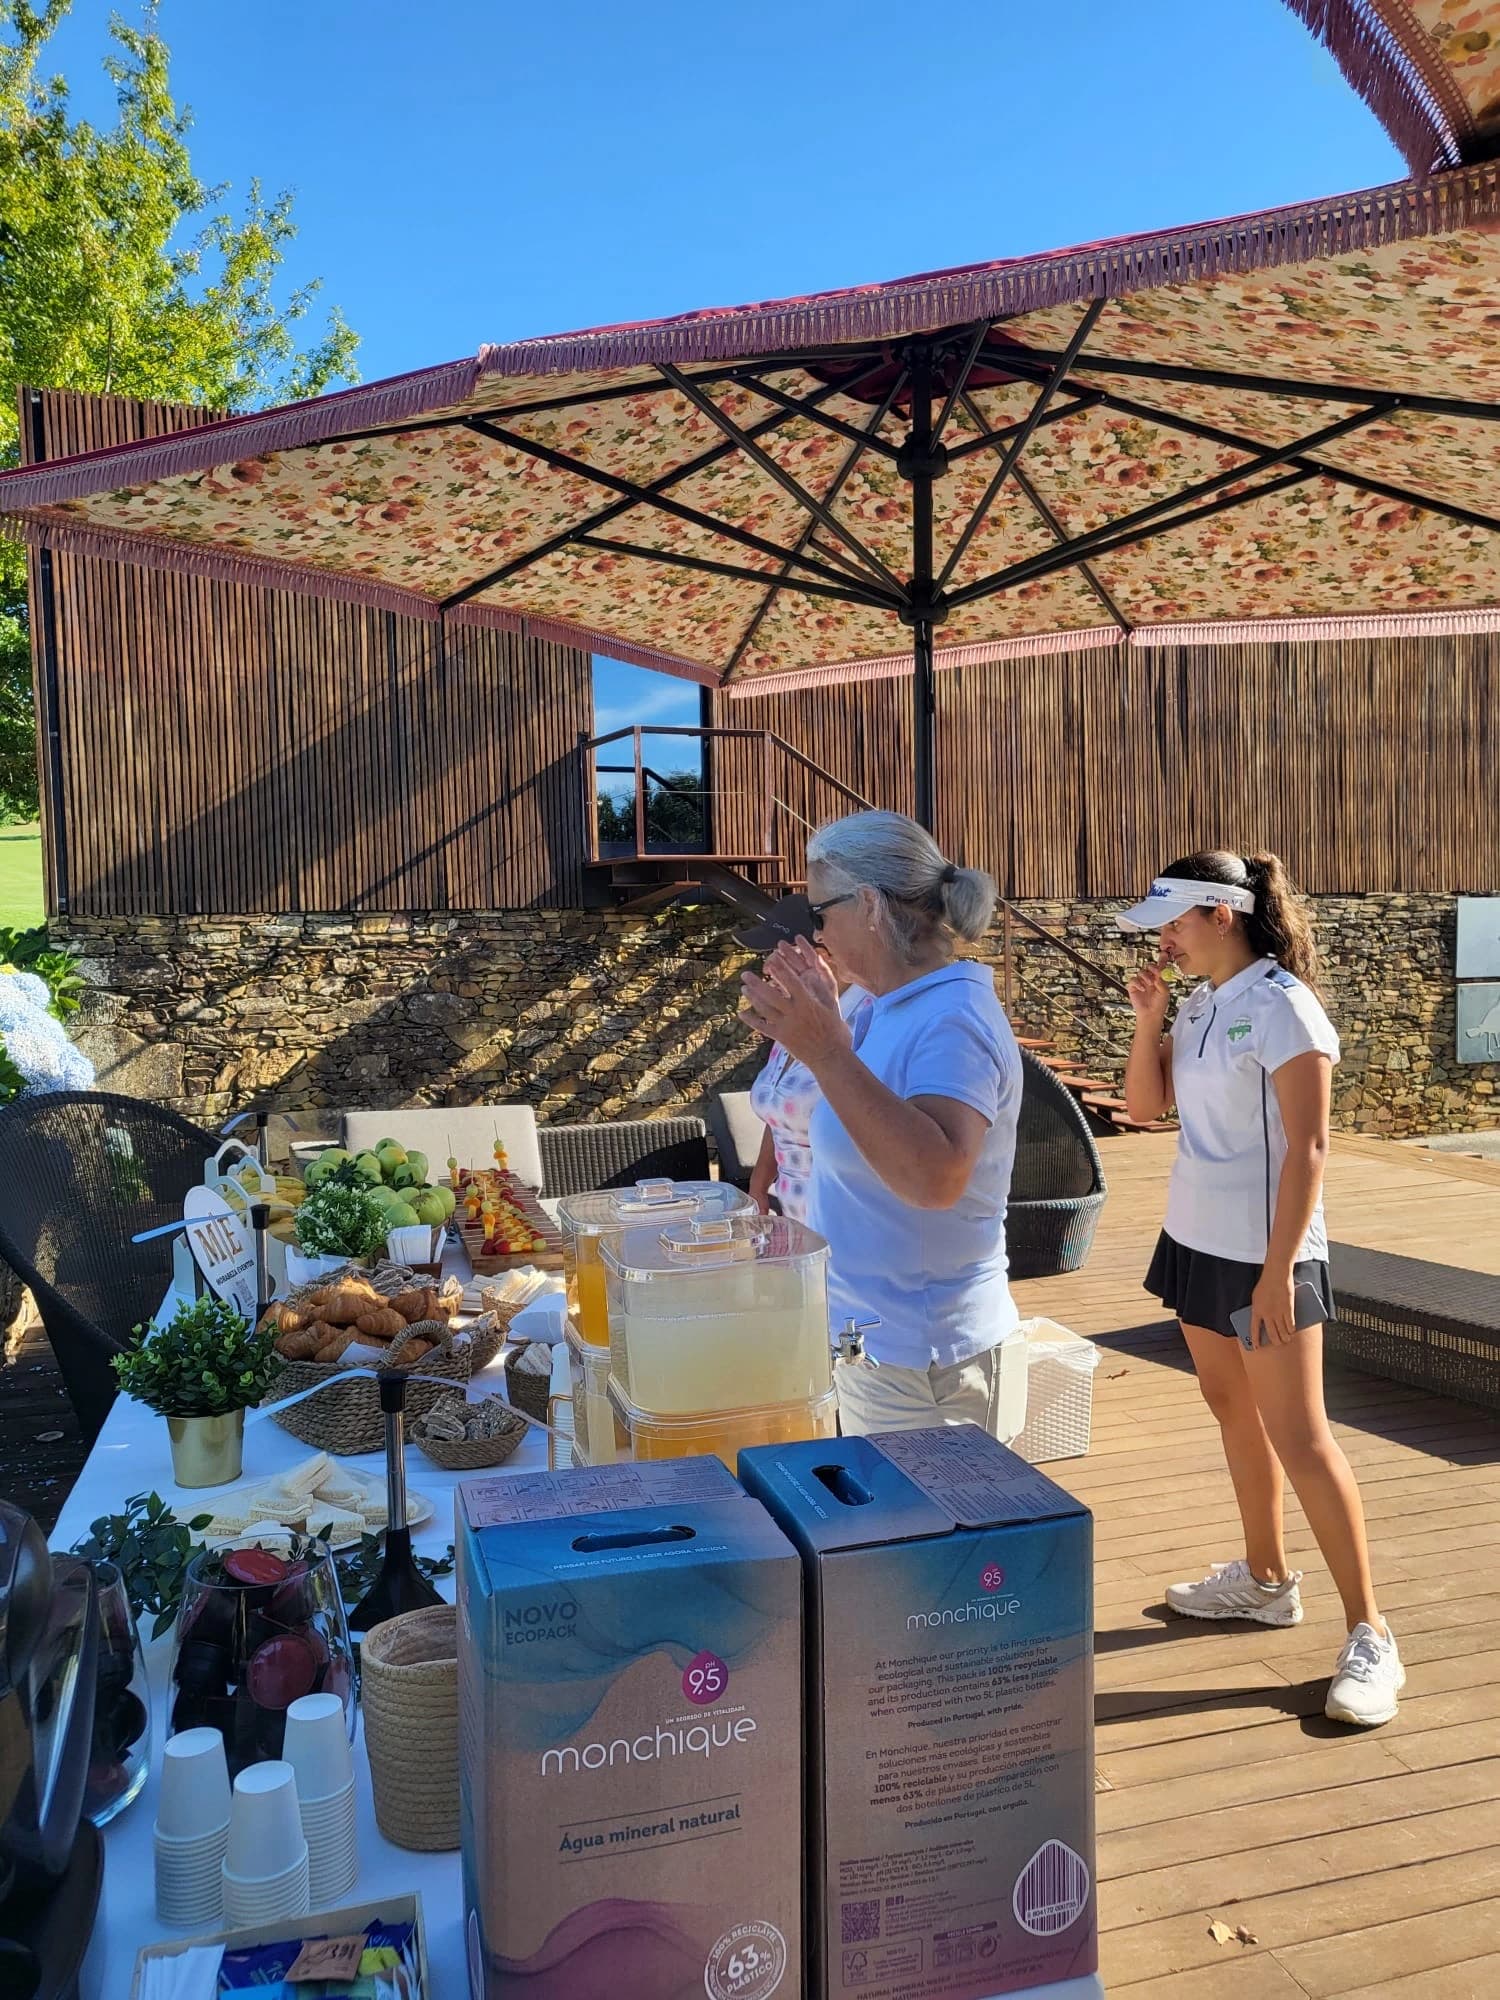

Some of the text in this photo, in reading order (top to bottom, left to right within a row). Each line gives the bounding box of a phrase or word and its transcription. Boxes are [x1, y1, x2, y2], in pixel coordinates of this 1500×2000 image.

[505, 1602, 578, 1629] NOVO
[906, 1599, 1021, 1630] monchique
[506, 1624, 577, 1646] ECOPACK
[874, 1662, 887, 1670] At
[888, 1654, 938, 1668] Monchique
[939, 1652, 954, 1660] our
[956, 1647, 988, 1660] priority
[1000, 1641, 1009, 1650] to
[1011, 1638, 1028, 1648] find
[1029, 1635, 1052, 1645] more
[868, 1685, 885, 1694] our
[936, 1674, 954, 1684] This
[956, 1671, 976, 1684] pack
[988, 1663, 1012, 1676] 100%
[1014, 1656, 1058, 1671] recyclable
[878, 1646, 1048, 1681] ecological and sustainable solutions for
[867, 1668, 1059, 1706] and its production contains 63% less plastic
[870, 1708, 895, 1718] when
[896, 1699, 942, 1714] compared
[944, 1696, 963, 1706] with
[964, 1694, 982, 1702] two
[996, 1686, 1024, 1700] plastic
[676, 1712, 702, 1722] SEGREDO
[712, 1704, 746, 1717] VITALIDADE
[907, 1716, 943, 1728] Produced
[986, 1706, 1002, 1716] with
[1003, 1703, 1025, 1714] pride.
[541, 1716, 757, 1776] monchique
[866, 1750, 878, 1760] En
[932, 1738, 966, 1749] nuestra
[968, 1728, 1008, 1744] prioridad
[1020, 1718, 1062, 1732] encontrar
[878, 1755, 926, 1770] soluciones
[1004, 1731, 1051, 1747] sostenibles
[874, 1782, 900, 1794] 100%
[902, 1774, 948, 1789] reciclable
[956, 1771, 967, 1780] su
[968, 1762, 1018, 1778] producción
[1018, 1752, 1056, 1767] contiene
[878, 1772, 899, 1783] para
[900, 1766, 941, 1778] nuestros
[982, 1754, 1001, 1763] Este
[1002, 1745, 1040, 1759] empaque
[870, 1796, 901, 1806] menos
[902, 1790, 923, 1800] 63%
[925, 1788, 936, 1796] de
[975, 1780, 986, 1788] en
[988, 1768, 1042, 1785] comparación
[1044, 1763, 1060, 1772] con
[896, 1804, 912, 1814] dos
[914, 1796, 962, 1810] botellones
[964, 1792, 975, 1801] de
[1012, 1782, 1022, 1791] de
[560, 1804, 742, 1854] Água mineral natural
[904, 1816, 942, 1828] Producido
[712, 1936, 732, 1959] 100%
